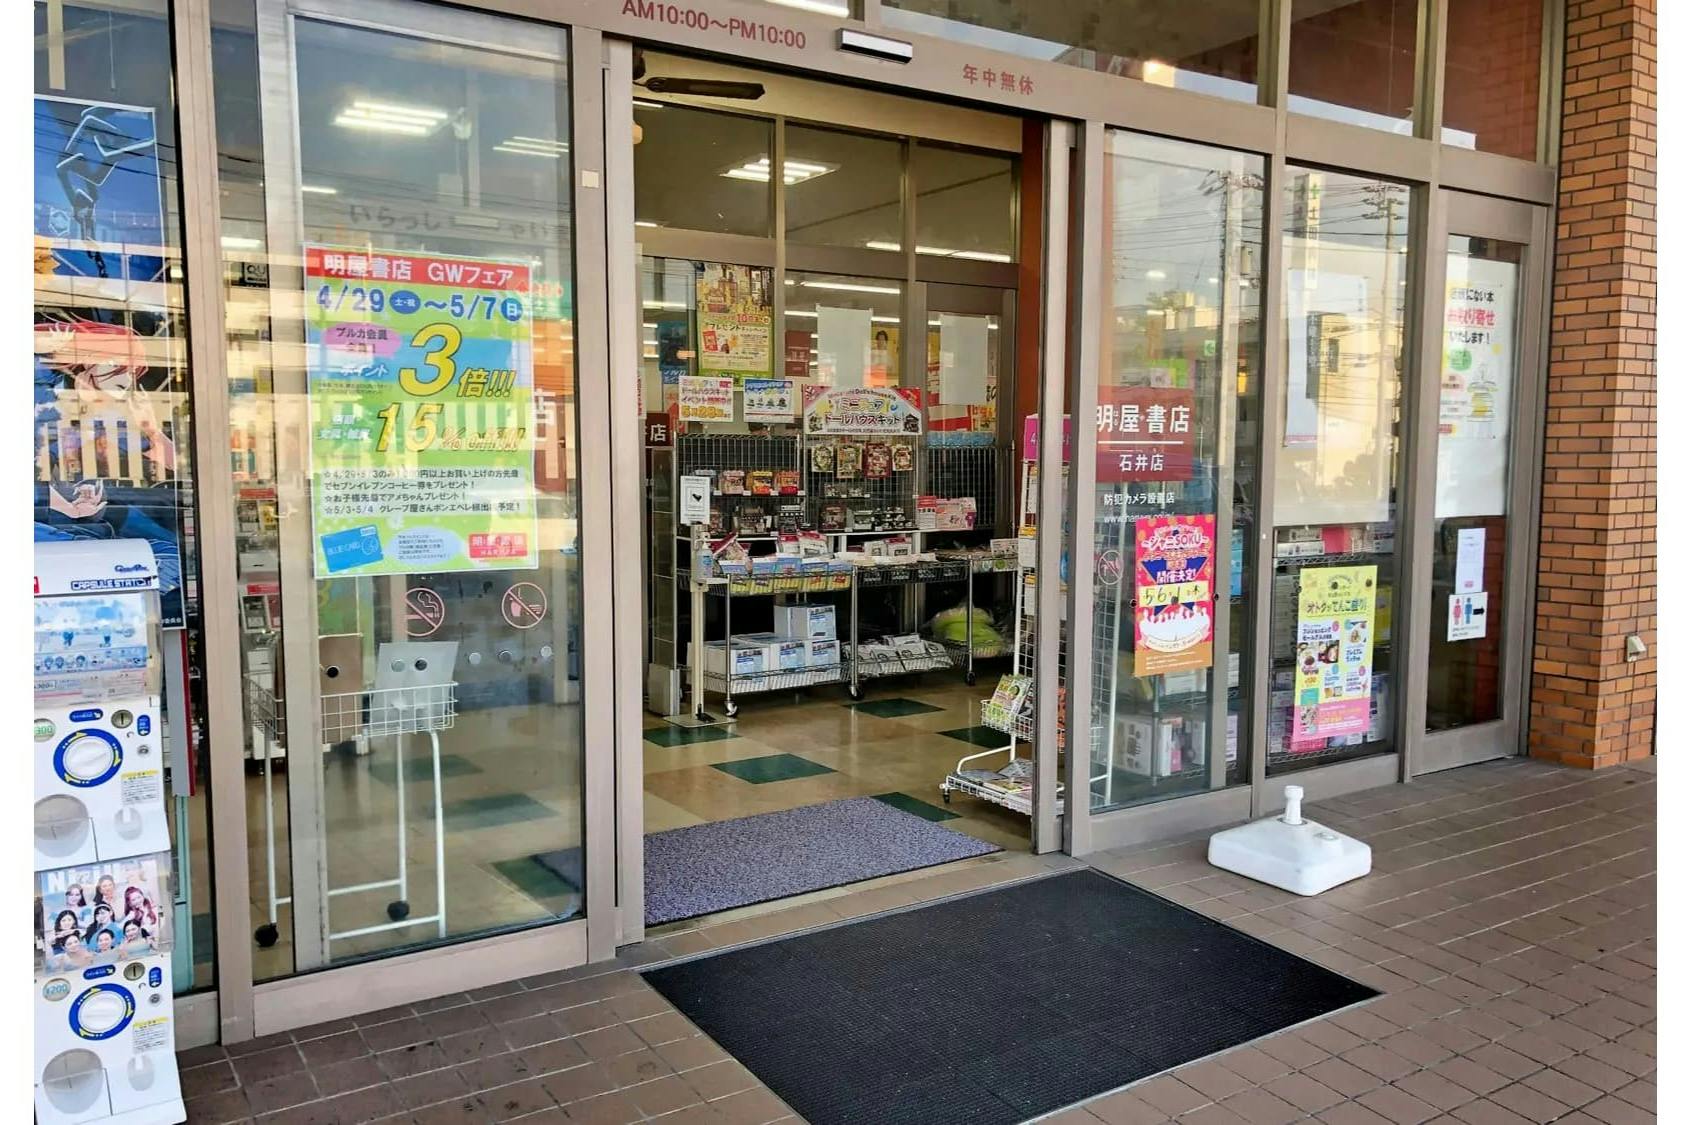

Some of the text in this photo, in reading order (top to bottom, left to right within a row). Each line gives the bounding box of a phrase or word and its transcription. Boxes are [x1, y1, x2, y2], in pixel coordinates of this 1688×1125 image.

[963, 63, 1033, 96] 年中無休
[323, 253, 514, 286] 明屋書店 GWフェア
[316, 284, 386, 313] 4/29
[506, 302, 519, 318] 日
[398, 322, 463, 397] 3
[375, 402, 445, 453] 15
[650, 423, 667, 442] 店
[1096, 403, 1190, 433] 明屋書店
[1119, 453, 1165, 472] 石井店
